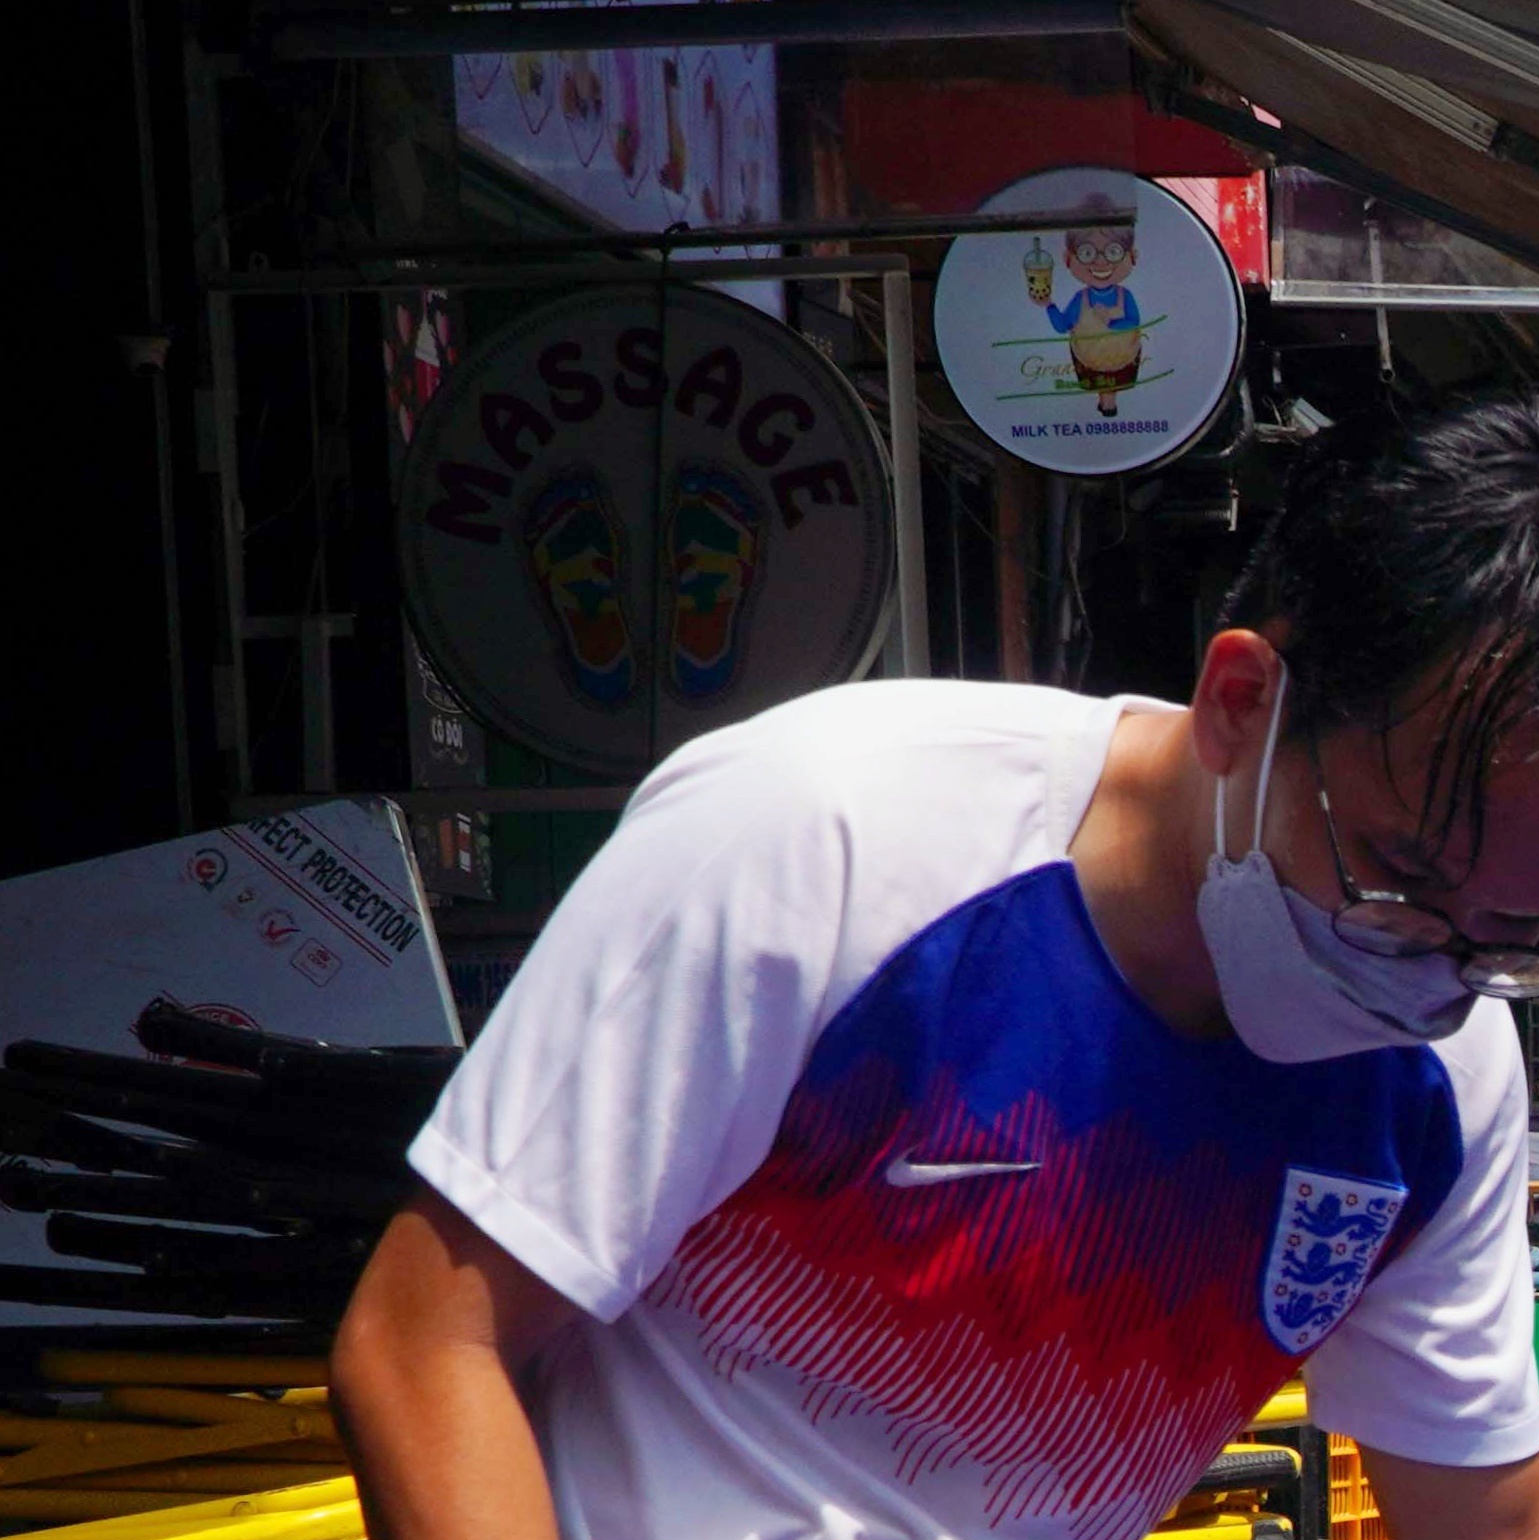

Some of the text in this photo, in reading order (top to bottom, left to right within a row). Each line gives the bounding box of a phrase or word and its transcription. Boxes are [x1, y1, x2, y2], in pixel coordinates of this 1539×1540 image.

[425, 328, 857, 542] MASSAGE
[1012, 424, 1048, 438] MILK
[1053, 423, 1082, 436] TEA
[302, 848, 420, 953] PROTECTION
